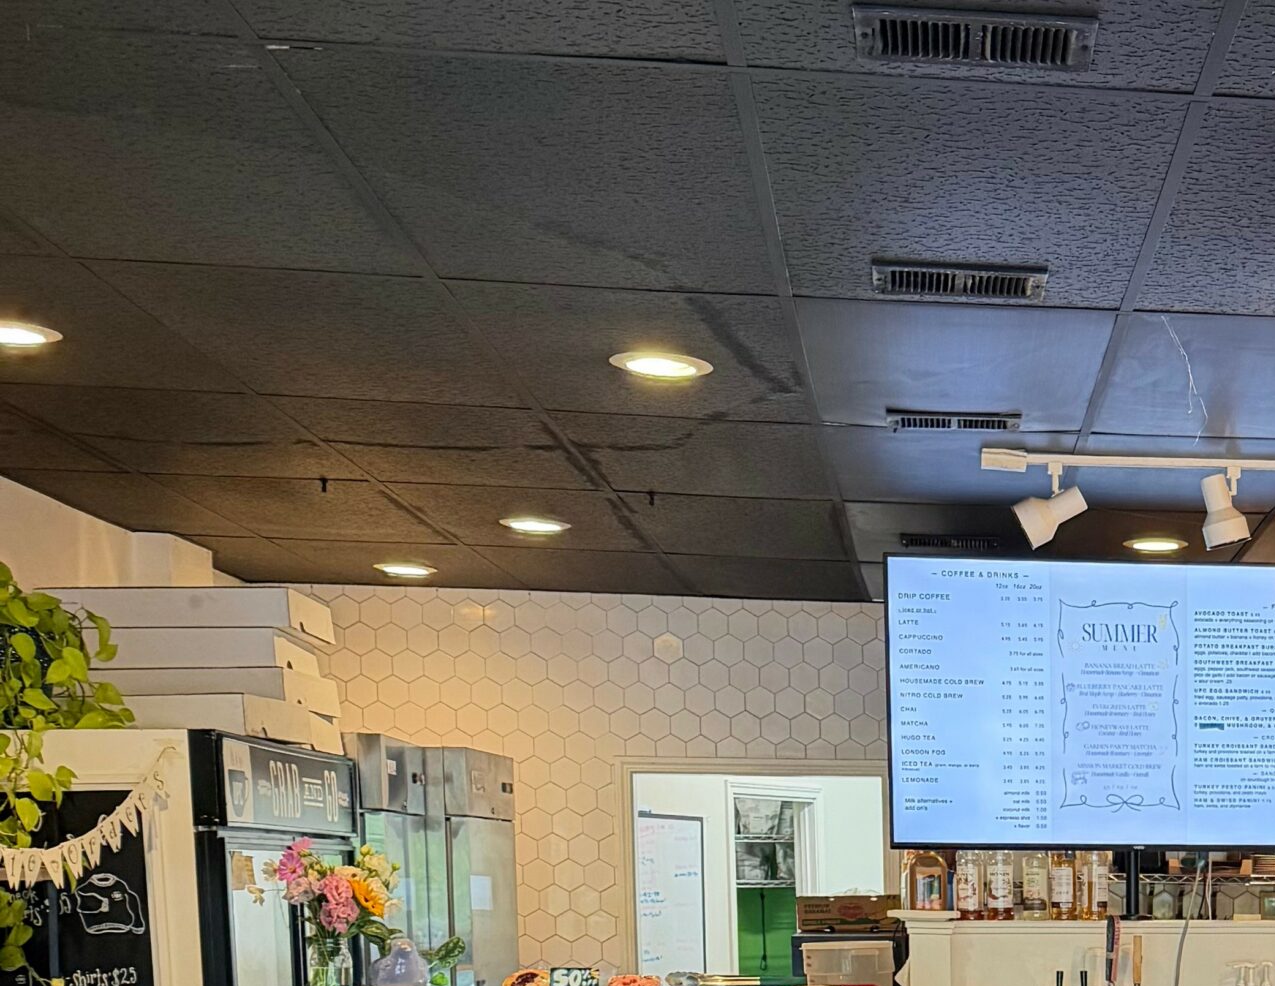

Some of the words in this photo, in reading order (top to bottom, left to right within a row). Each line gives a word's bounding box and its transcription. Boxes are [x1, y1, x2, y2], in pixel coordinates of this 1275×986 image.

[941, 570, 975, 578] COFFEE
[987, 571, 1019, 579] DRINKS
[898, 592, 917, 600] DRIP
[1082, 623, 1158, 643] SUMMER
[1102, 644, 1137, 652] MENU
[269, 759, 301, 819] GRAB
[303, 784, 325, 801] AND
[324, 769, 339, 824] GO
